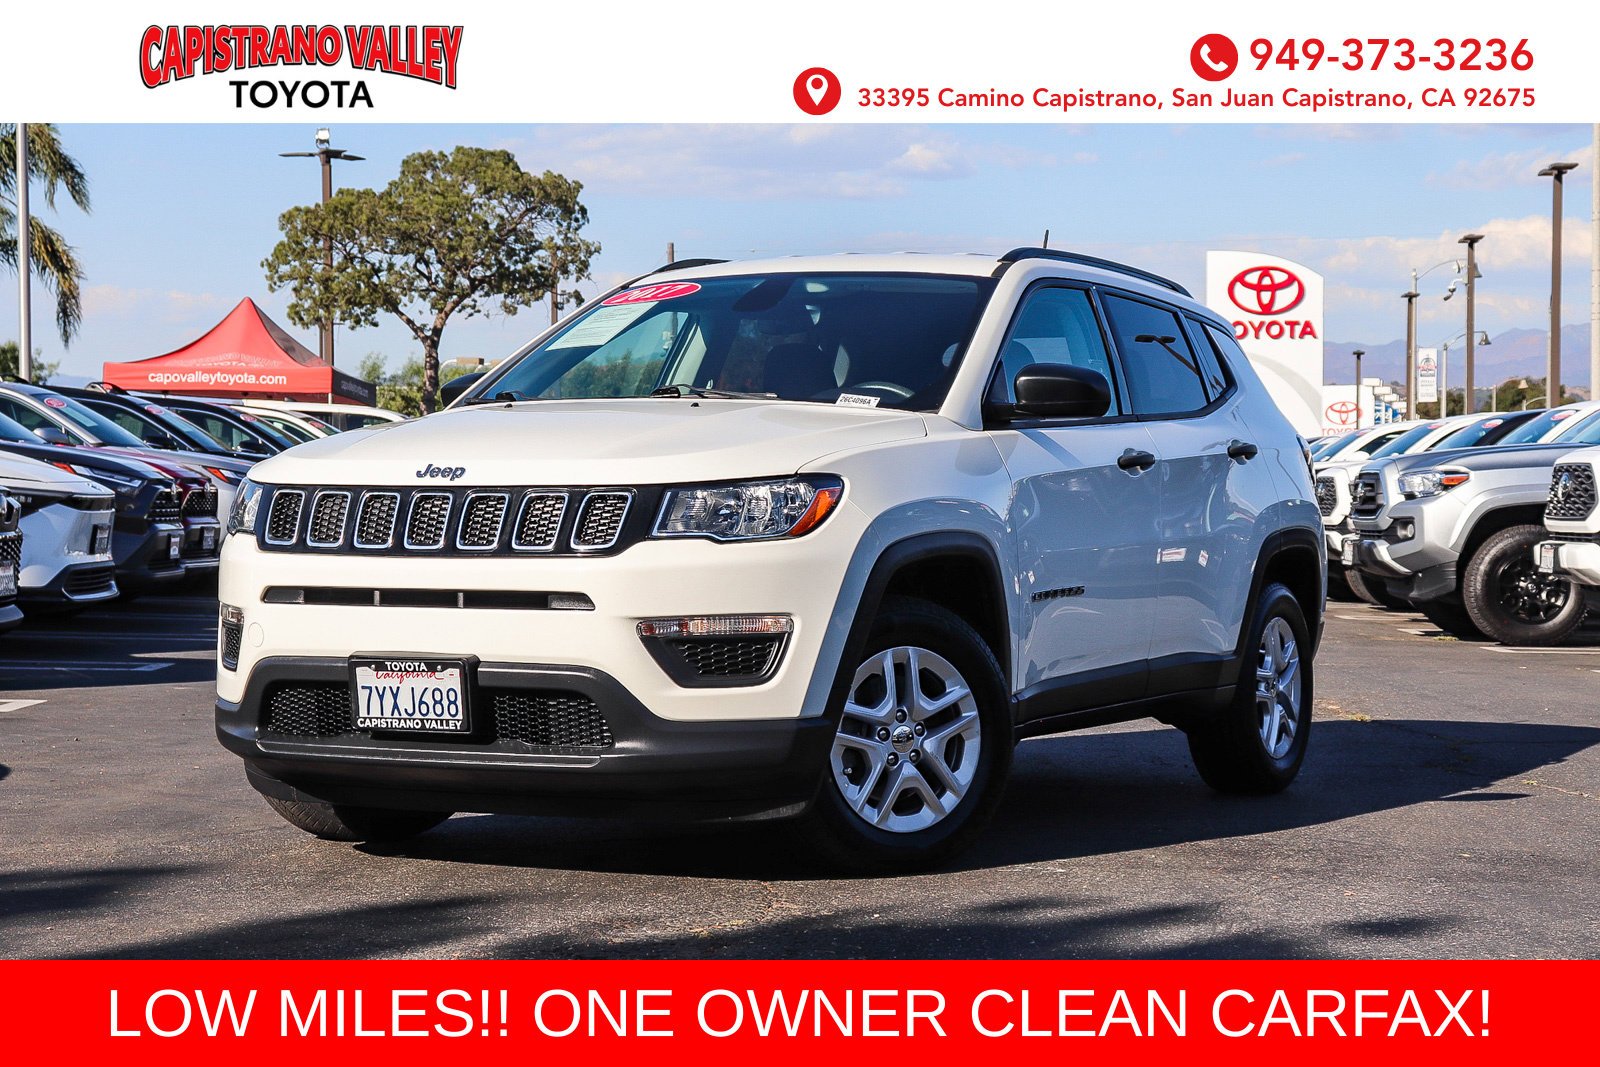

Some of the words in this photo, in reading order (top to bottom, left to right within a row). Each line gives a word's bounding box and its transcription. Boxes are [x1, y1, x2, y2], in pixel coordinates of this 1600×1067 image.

[1232, 320, 1318, 340] OYOTA
[148, 371, 287, 386] capovalleytoyota.com
[416, 463, 466, 481] Jeep
[385, 662, 427, 672] TOYOTA
[361, 685, 459, 718] 7YXJ688
[357, 718, 422, 729] CAPISTRANO
[424, 719, 462, 730] VALLEY
